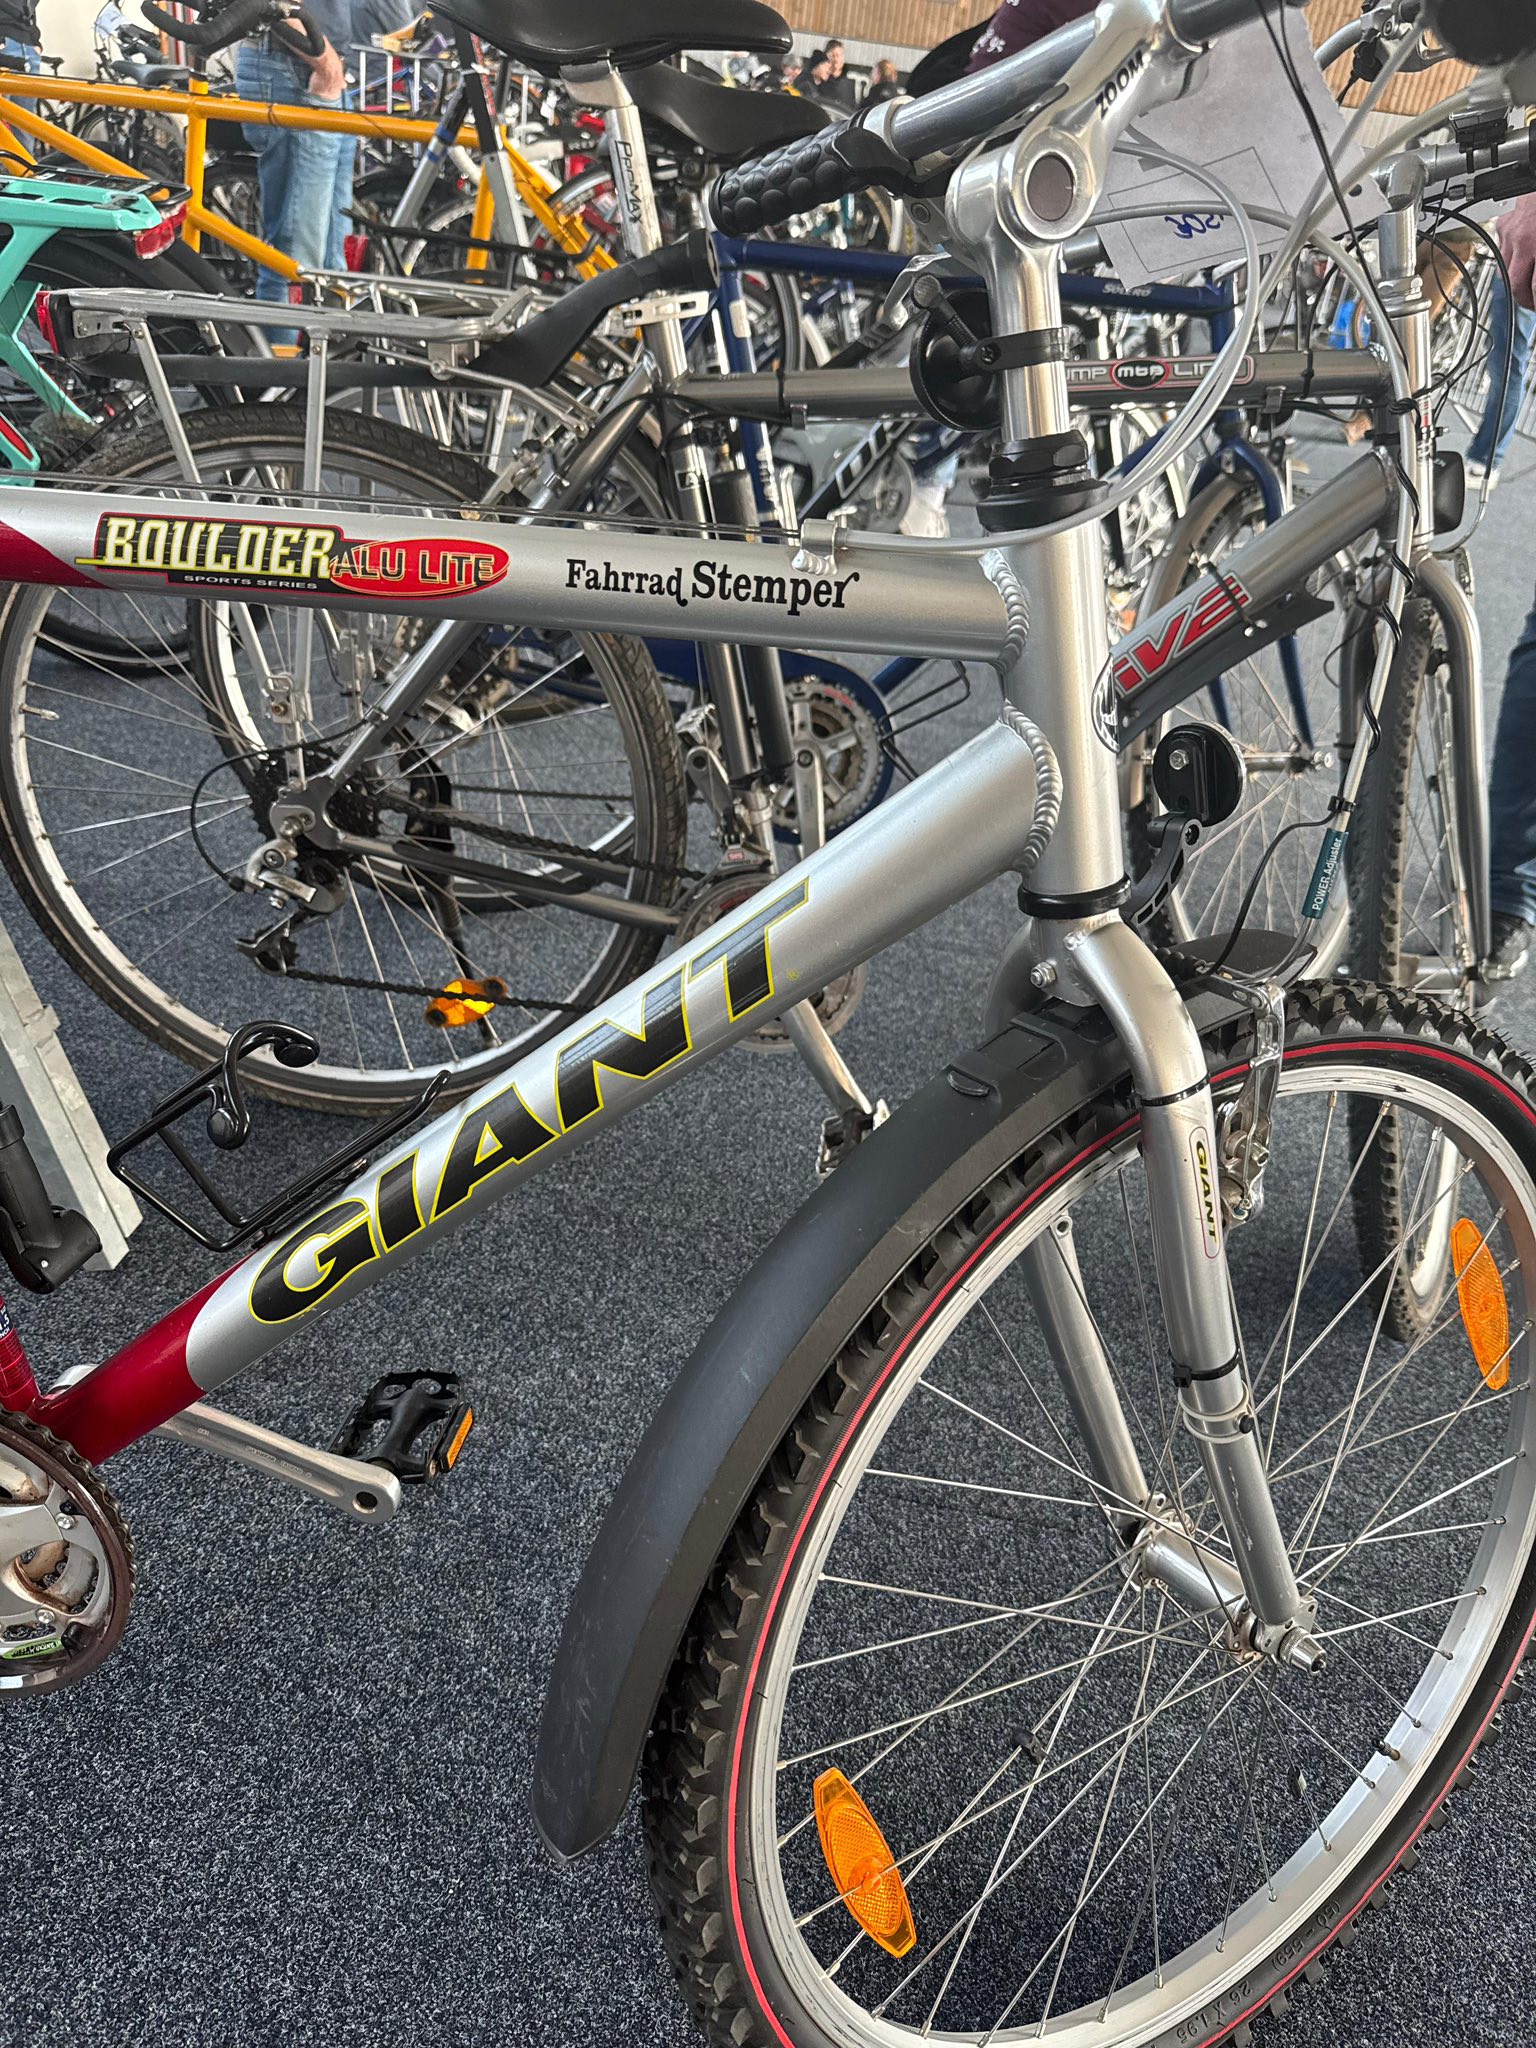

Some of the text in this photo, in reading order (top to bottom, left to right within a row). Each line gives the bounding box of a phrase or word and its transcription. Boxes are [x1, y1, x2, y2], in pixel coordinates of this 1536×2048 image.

[1095, 48, 1144, 120] ZOOM
[103, 516, 496, 586] BOULDER ALU LITE
[183, 574, 318, 590] SPORTS SERIES
[565, 558, 860, 616] Fahrrad Stemper
[1312, 876, 1329, 911] POWER
[1323, 838, 1342, 876] Adjuster
[248, 876, 810, 1324] GIANT
[1196, 1141, 1217, 1243] GIANT
[1318, 1900, 1342, 1928] (50
[1272, 1942, 1305, 1973] 559)
[1229, 1979, 1251, 2006] 26
[1176, 2013, 1209, 2043] 1.95
